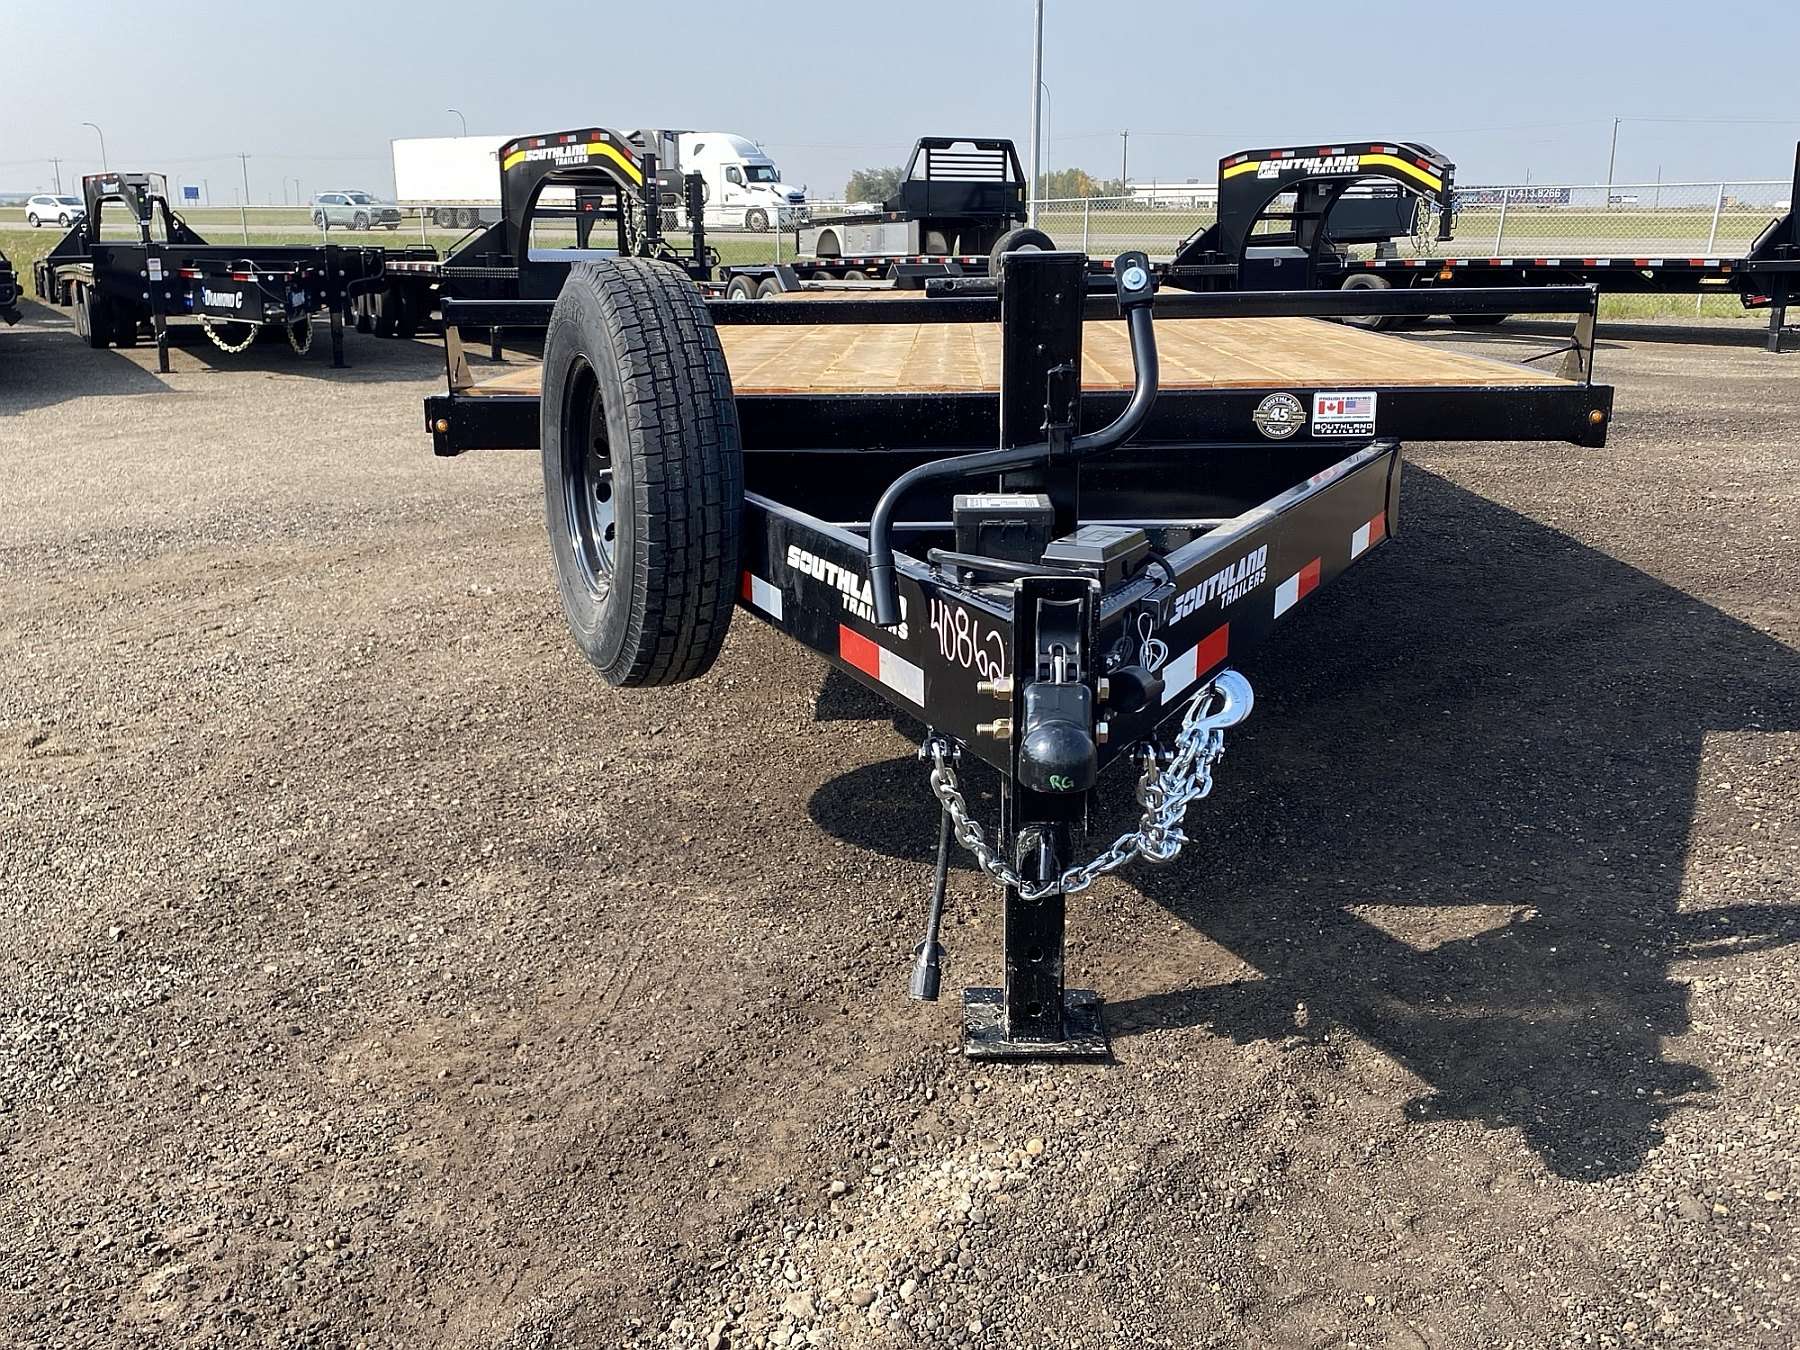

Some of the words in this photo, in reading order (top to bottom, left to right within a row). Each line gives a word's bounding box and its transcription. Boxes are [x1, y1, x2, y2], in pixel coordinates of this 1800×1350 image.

[525, 144, 588, 161] SOUTHLAND
[555, 155, 589, 166] TRAILERS
[1259, 155, 1361, 170] SOUTHLAND
[1307, 165, 1360, 175] TRAILERS
[235, 291, 243, 309] C
[1270, 408, 1289, 421] 45
[786, 544, 908, 621] SOUTHLA
[1168, 543, 1268, 627] SOUTHLAND
[1220, 566, 1267, 610] TRAILERS
[930, 598, 1005, 683] 40862
[1050, 775, 1074, 791] RG
